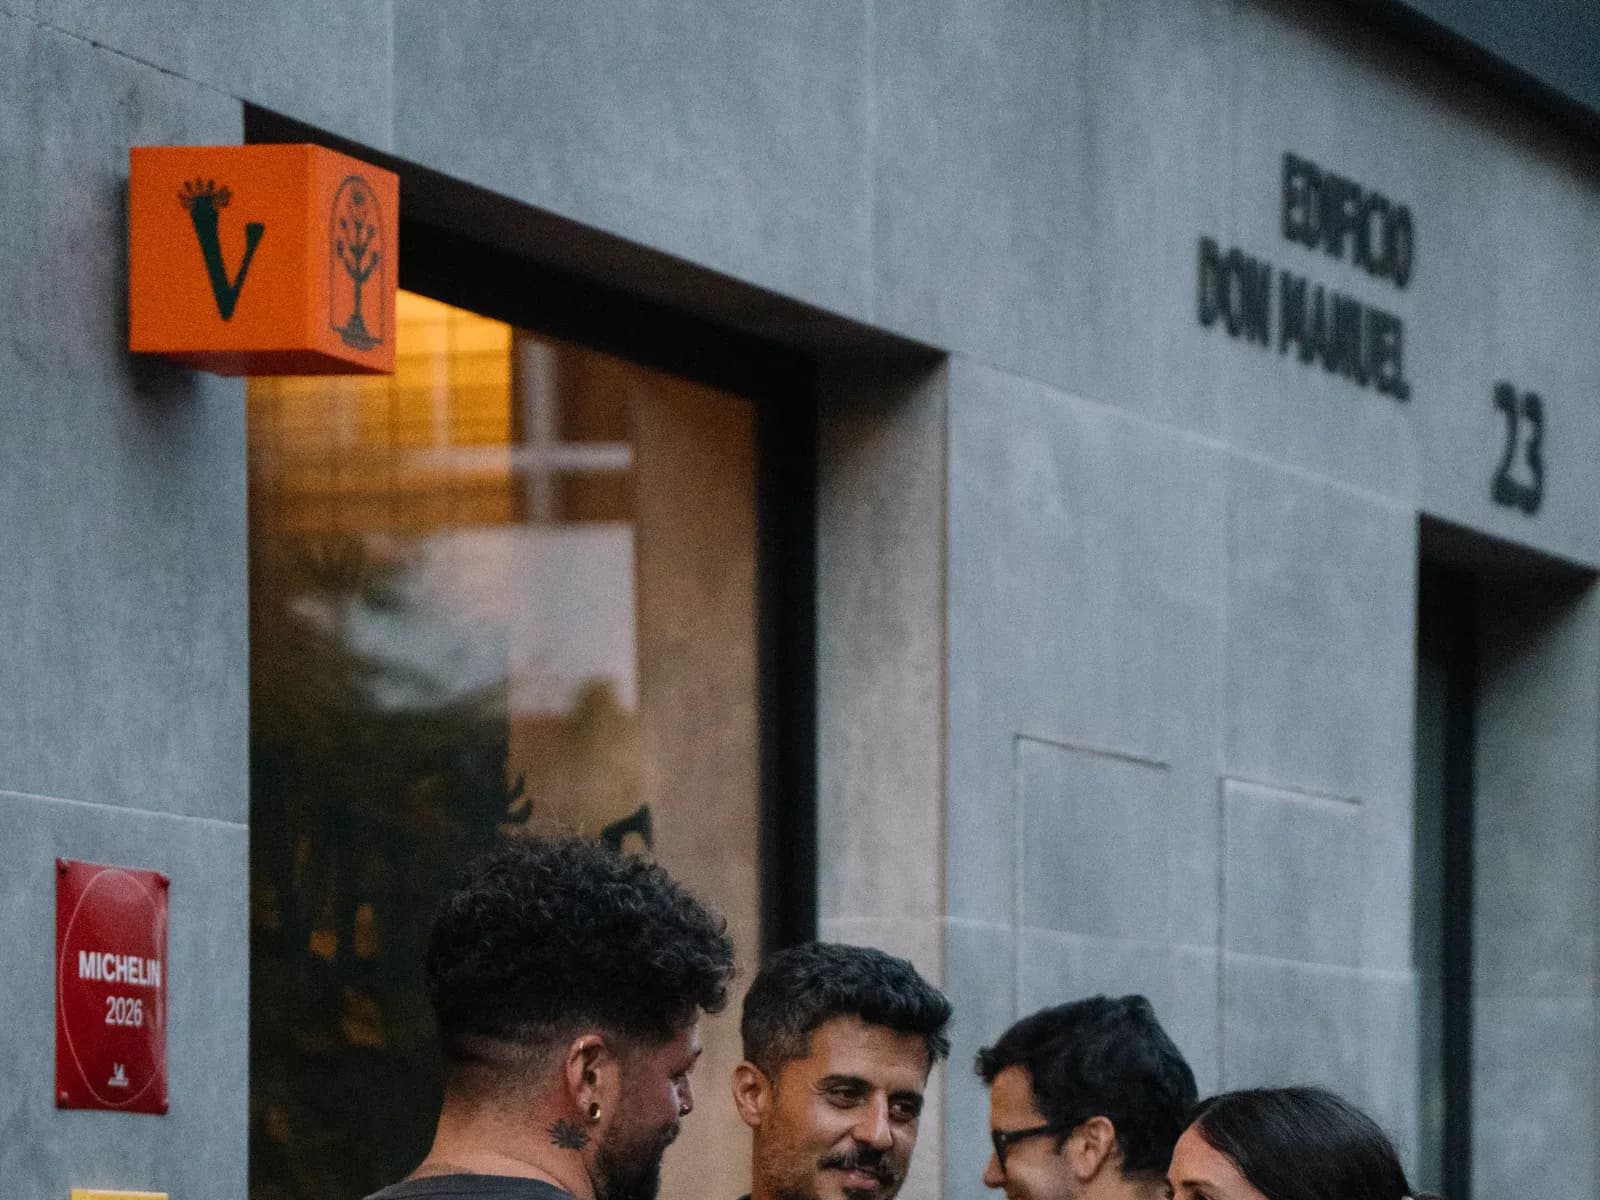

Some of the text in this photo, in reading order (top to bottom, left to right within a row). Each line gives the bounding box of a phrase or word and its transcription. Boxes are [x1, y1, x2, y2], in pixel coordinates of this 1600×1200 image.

[1197, 235, 1411, 402] DON MANUEL
[1491, 380, 1544, 517] 23
[79, 950, 162, 987] MICHELIN
[105, 995, 143, 1026] 2026
